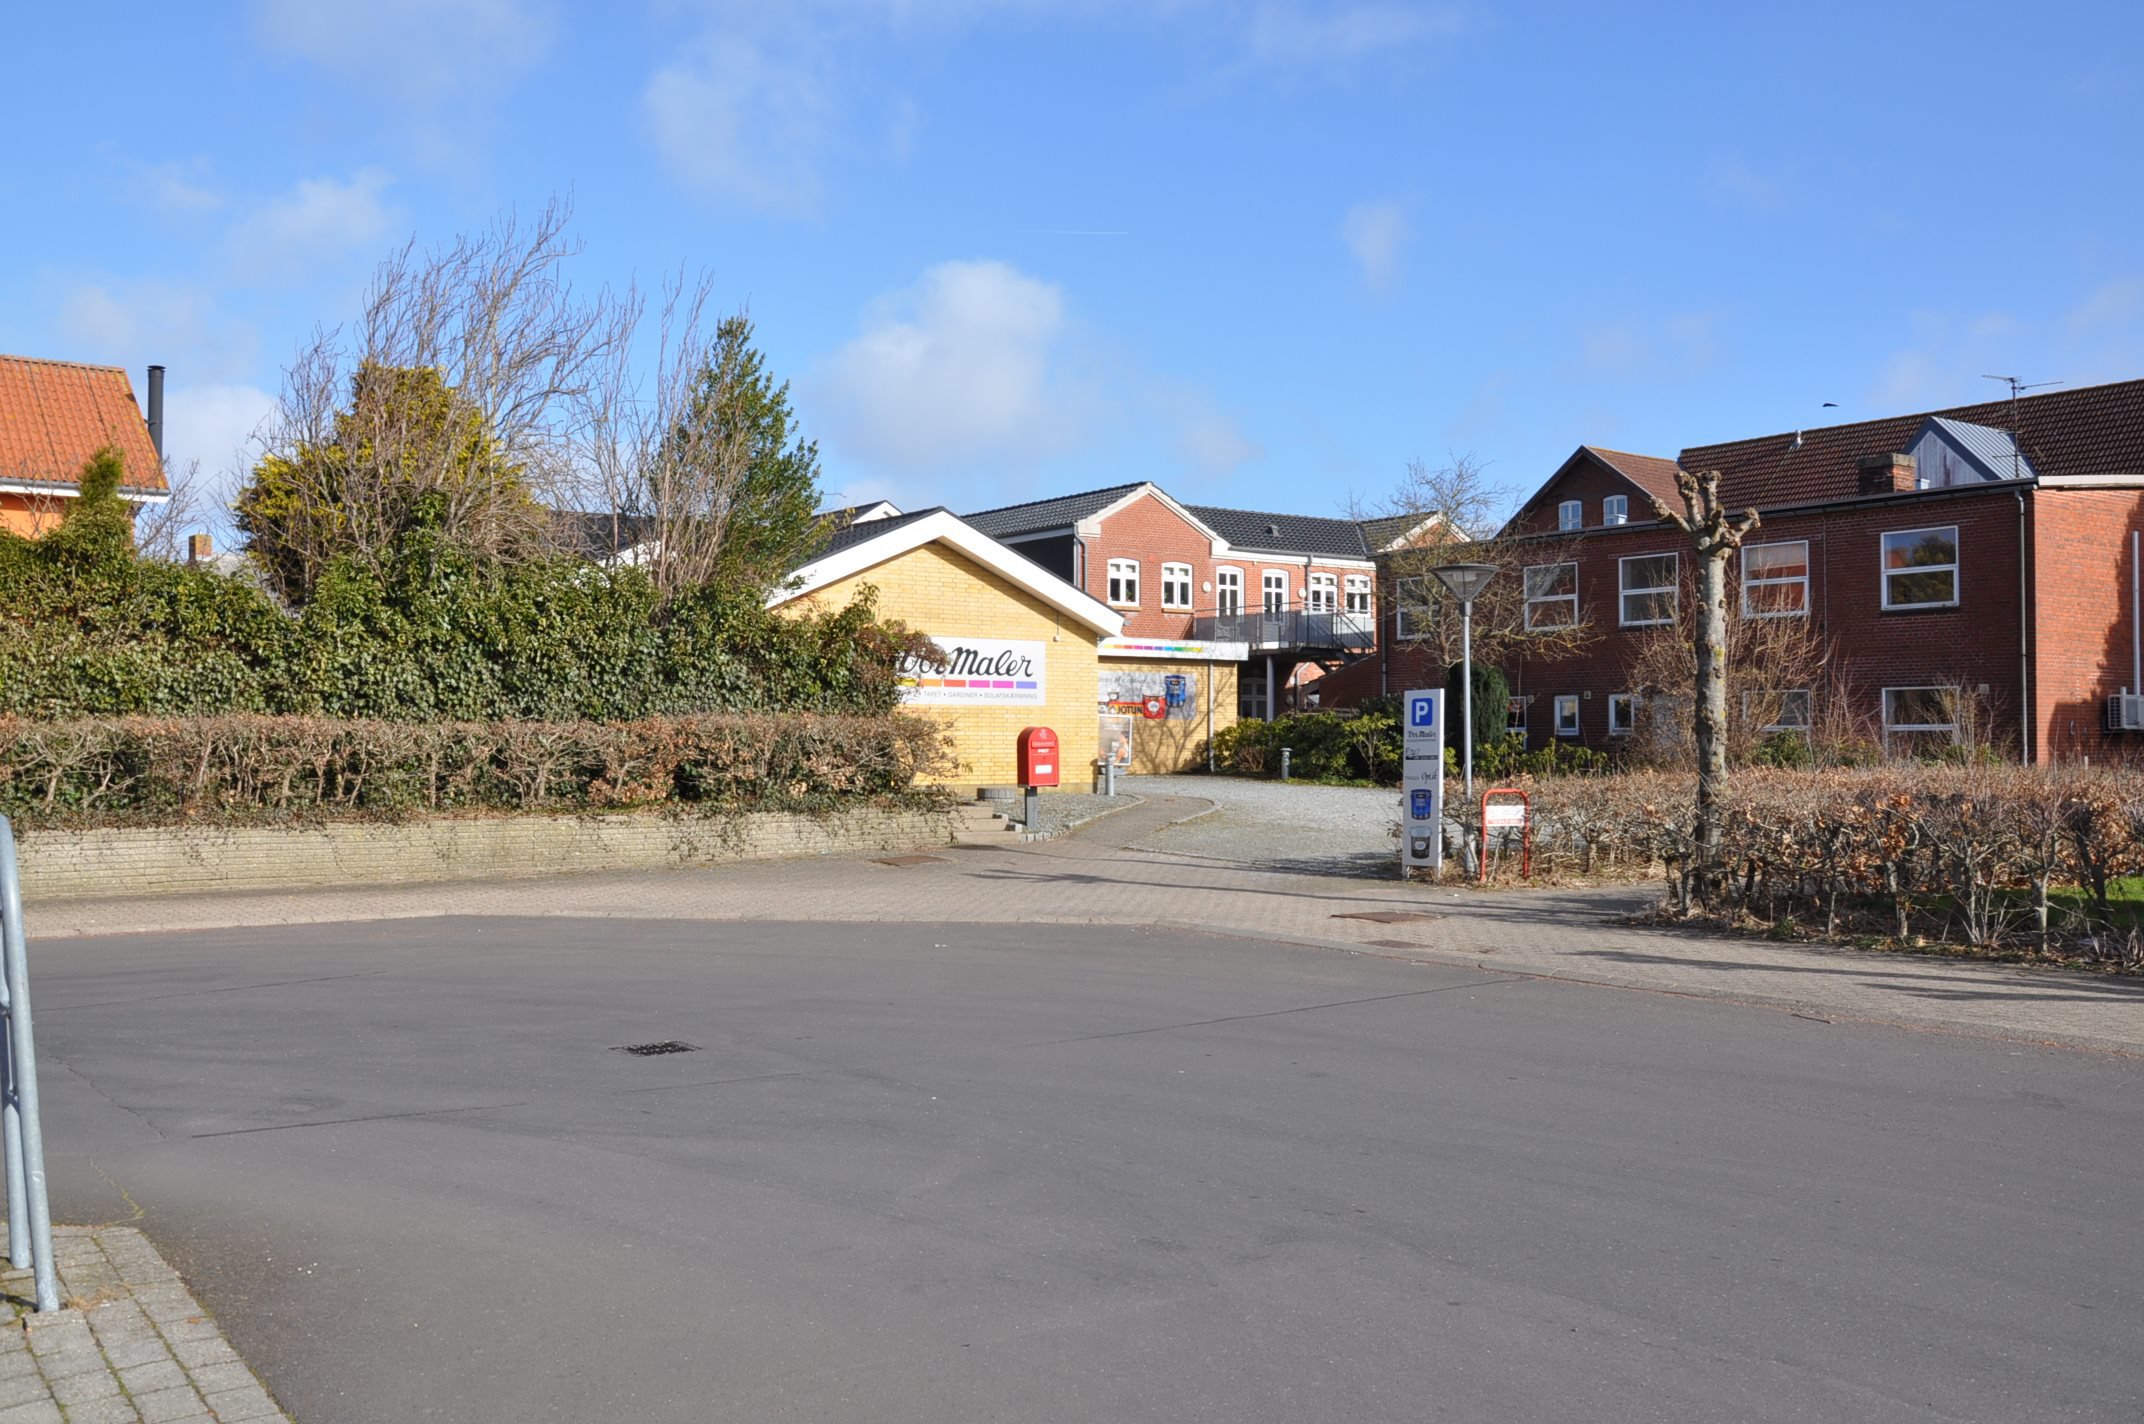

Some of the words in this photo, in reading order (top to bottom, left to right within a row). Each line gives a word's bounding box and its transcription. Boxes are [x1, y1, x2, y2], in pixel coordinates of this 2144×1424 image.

[948, 646, 1034, 678] Maler
[1117, 705, 1143, 714] JOTUN
[1415, 701, 1429, 723] P
